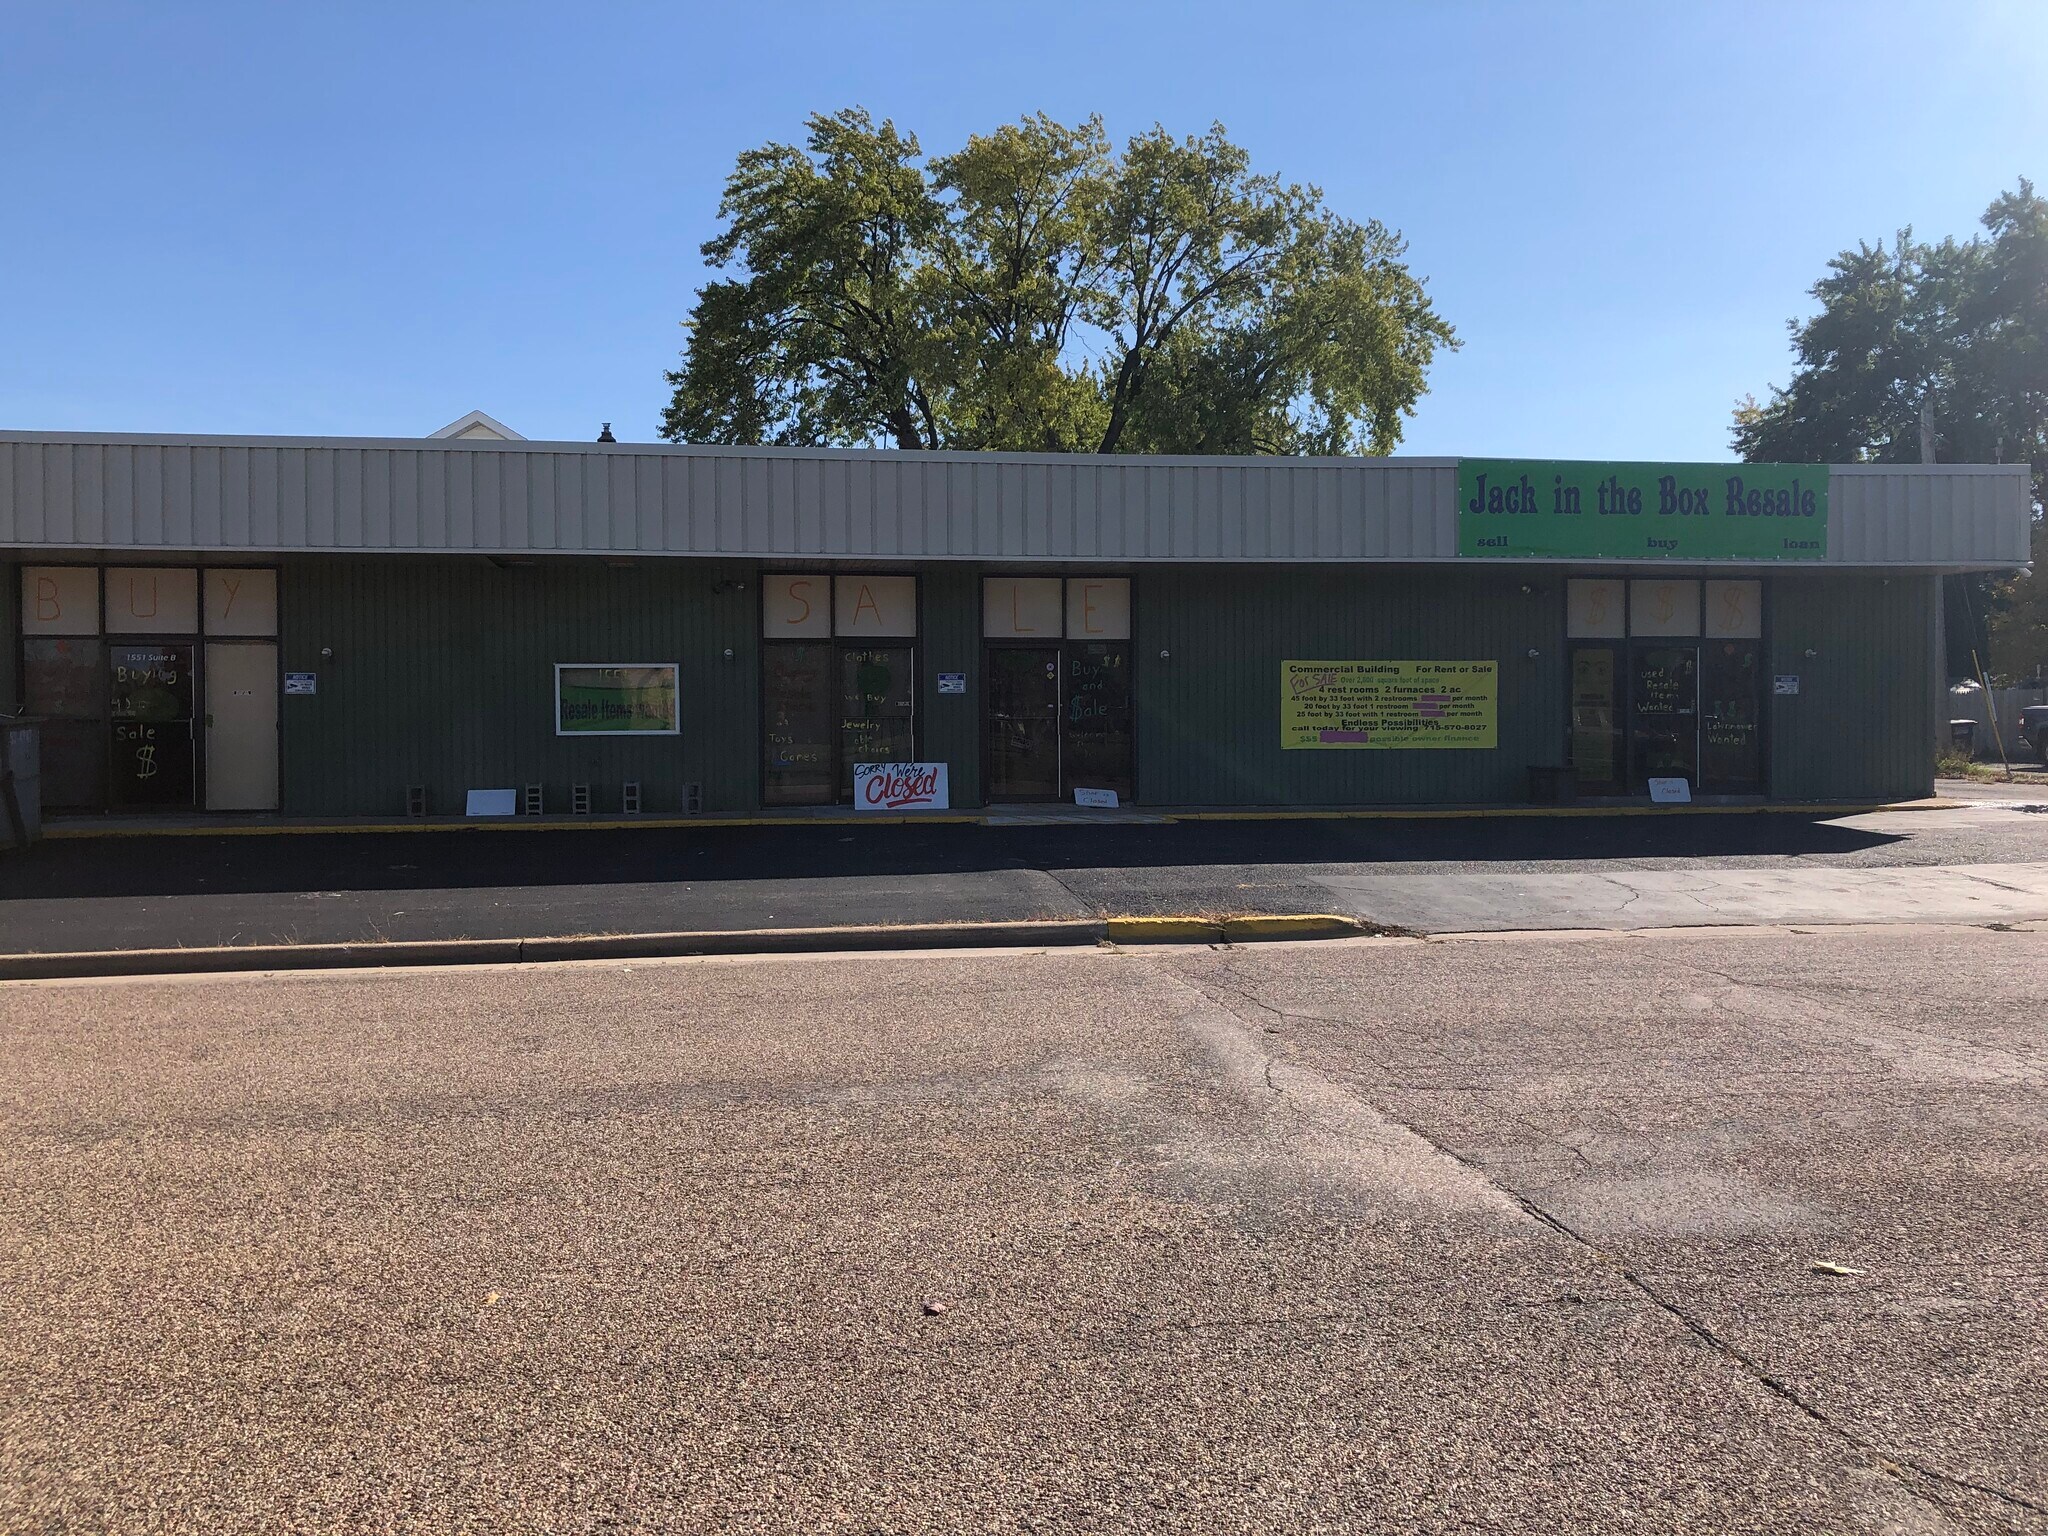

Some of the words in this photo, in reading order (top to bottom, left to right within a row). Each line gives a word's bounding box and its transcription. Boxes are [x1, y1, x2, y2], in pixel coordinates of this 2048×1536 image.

[1469, 473, 1538, 514] Jack
[1554, 475, 1581, 514] in
[1598, 476, 1642, 514] the
[1659, 475, 1710, 515] Box
[1726, 476, 1816, 516] Resale
[1477, 536, 1508, 547] sell
[1647, 537, 1678, 550] buy
[1784, 538, 1820, 549] loan
[1357, 665, 1400, 674] Building
[867, 694, 886, 703] Buy
[841, 720, 880, 731] Jewelry
[117, 724, 155, 741] Sale
[769, 734, 793, 743] Toys
[1708, 733, 1745, 745] Wanted
[866, 767, 937, 804] Closed
